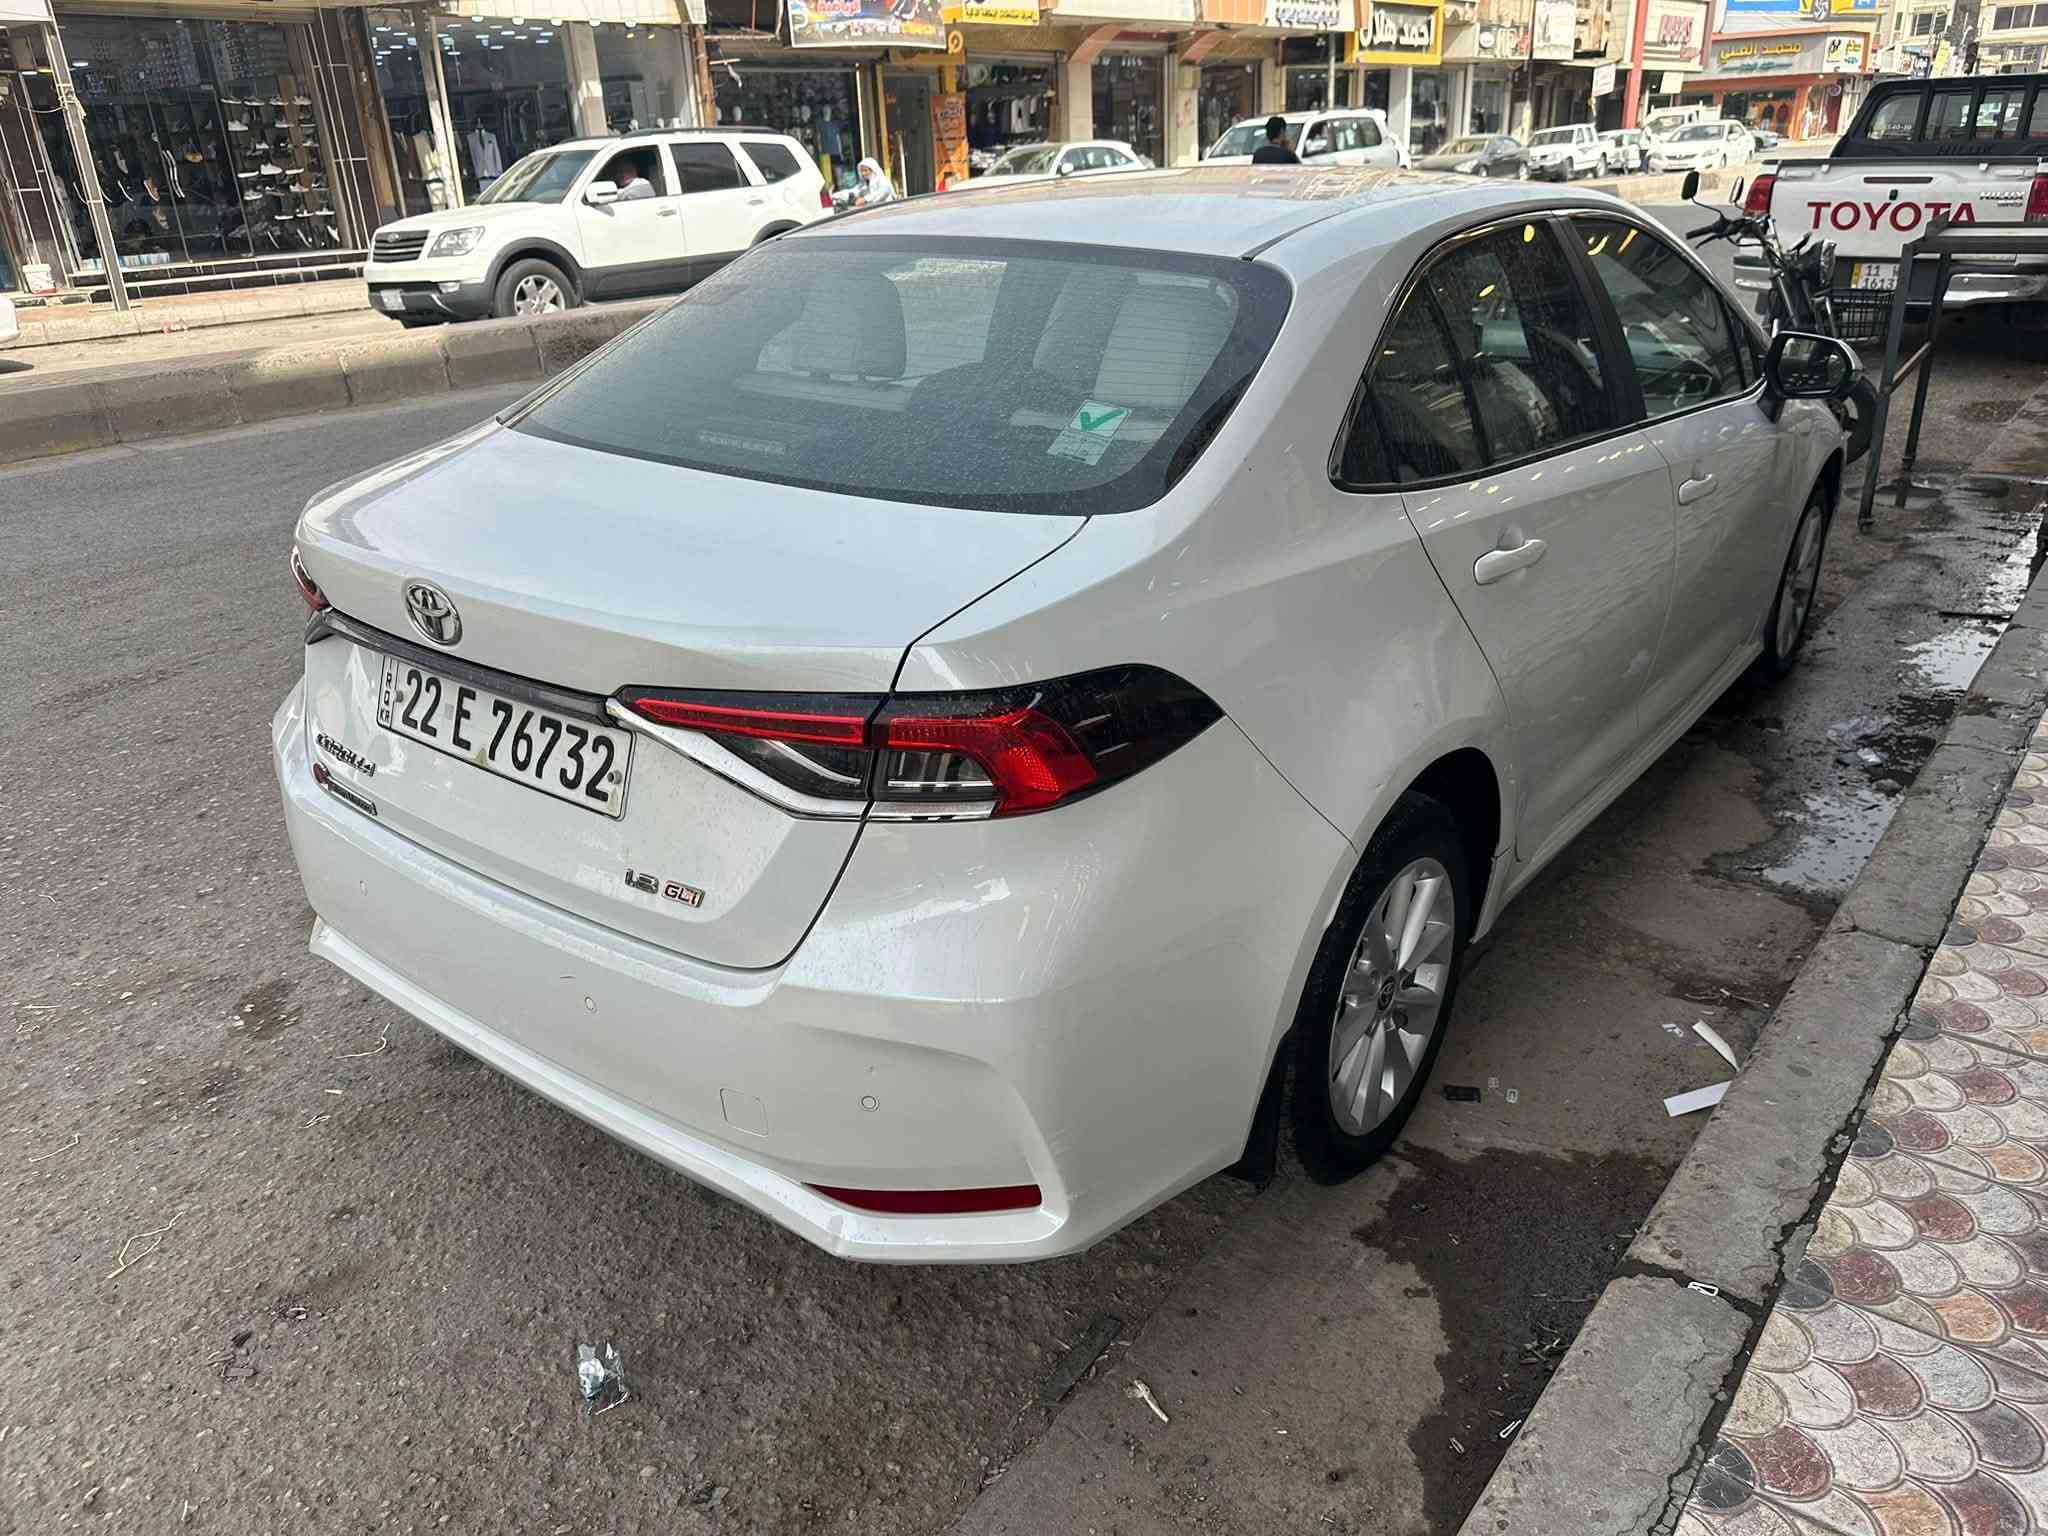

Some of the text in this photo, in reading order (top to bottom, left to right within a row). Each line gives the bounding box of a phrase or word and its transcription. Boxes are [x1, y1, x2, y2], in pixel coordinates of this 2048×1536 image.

[1359, 1, 1398, 47] هلال
[1763, 42, 1802, 58] محمد
[1808, 201, 1976, 231] TOYOTA
[1866, 264, 1881, 277] 11
[401, 668, 615, 803] 22 E 76732
